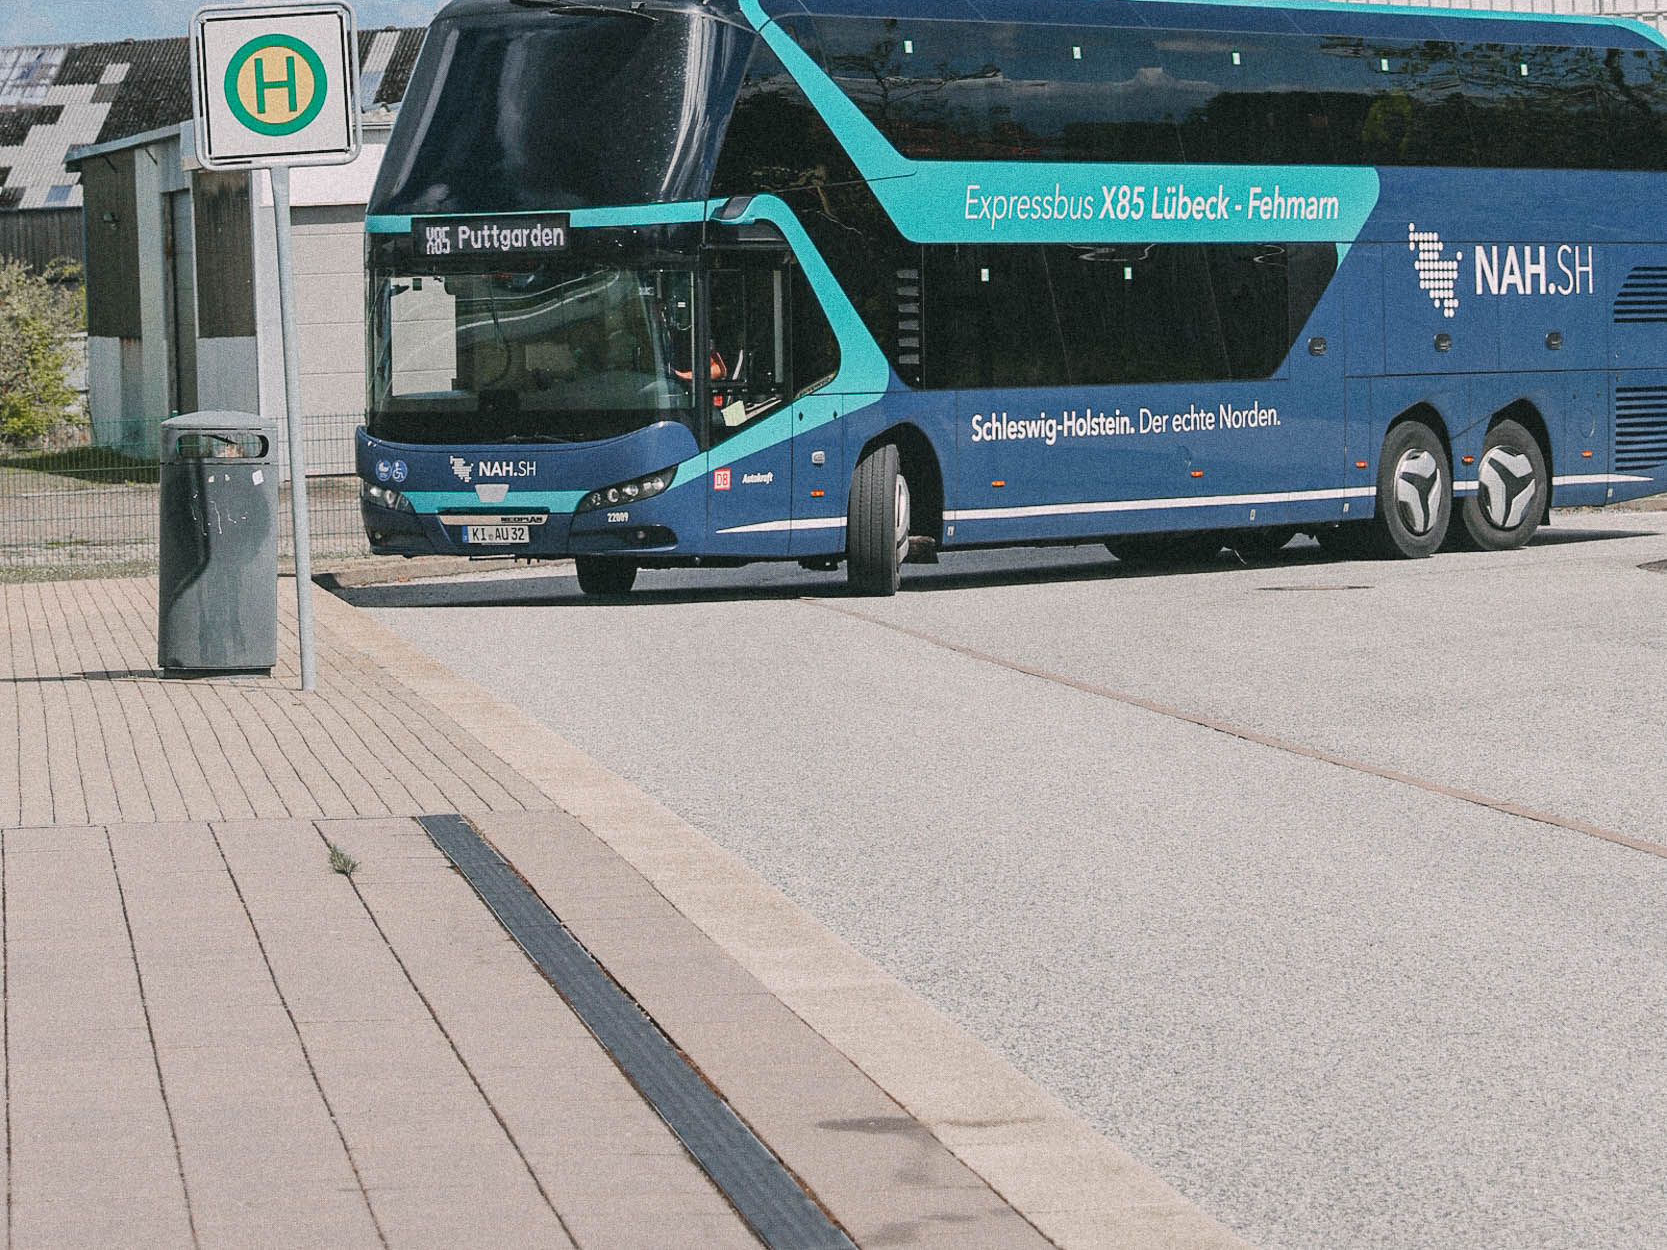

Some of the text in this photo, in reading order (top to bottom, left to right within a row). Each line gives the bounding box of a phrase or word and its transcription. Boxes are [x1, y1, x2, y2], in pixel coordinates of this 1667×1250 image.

[254, 56, 297, 114] H
[965, 183, 1094, 230] Expressbus
[1099, 185, 1145, 219] X85
[1151, 184, 1230, 220] Lübeck
[1247, 186, 1340, 220] Fehmarn
[458, 223, 564, 251] Puttgarden
[1474, 245, 1594, 296] NAH.SH
[971, 402, 1281, 446] Schleswig-Holstein. Der echte Norden.
[479, 461, 536, 477] NAH.SH
[716, 473, 729, 486] DB
[472, 527, 525, 541] KI AU 32
